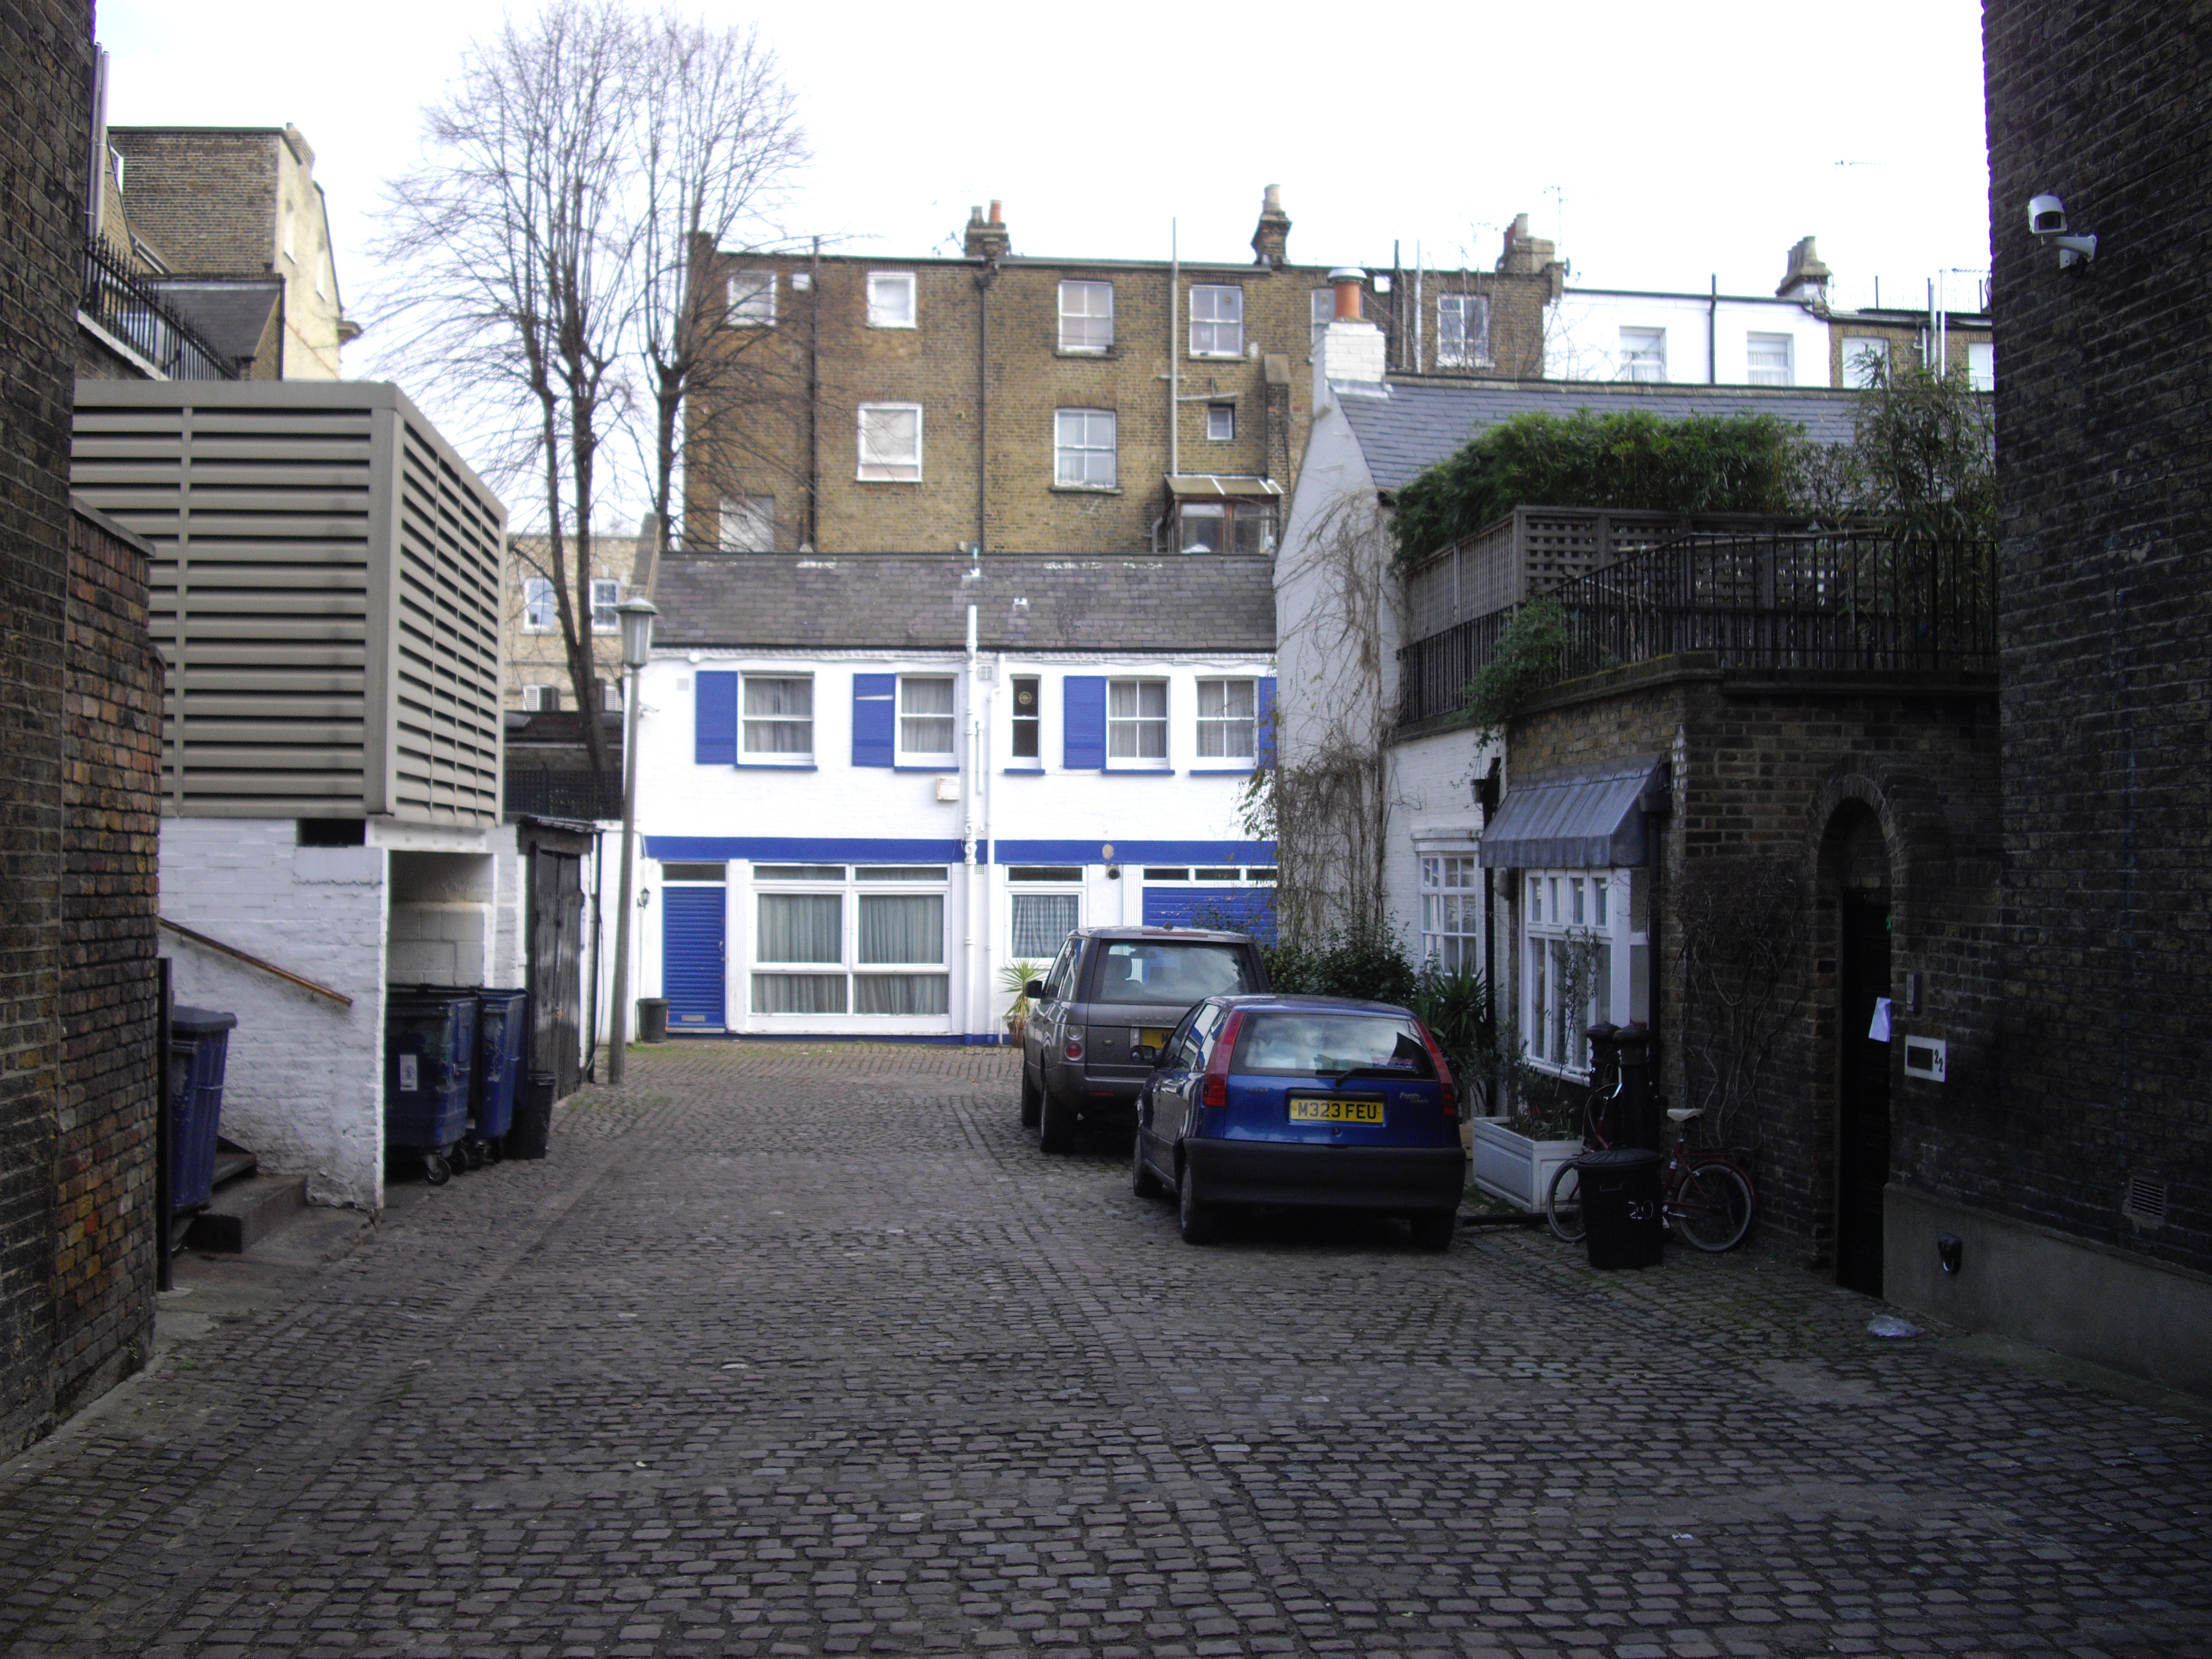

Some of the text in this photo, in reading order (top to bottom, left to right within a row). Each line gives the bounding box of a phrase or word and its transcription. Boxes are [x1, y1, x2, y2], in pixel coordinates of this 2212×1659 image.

[1934, 1049, 1943, 1072] 22
[1298, 1102, 1376, 1119] M323 FEU
